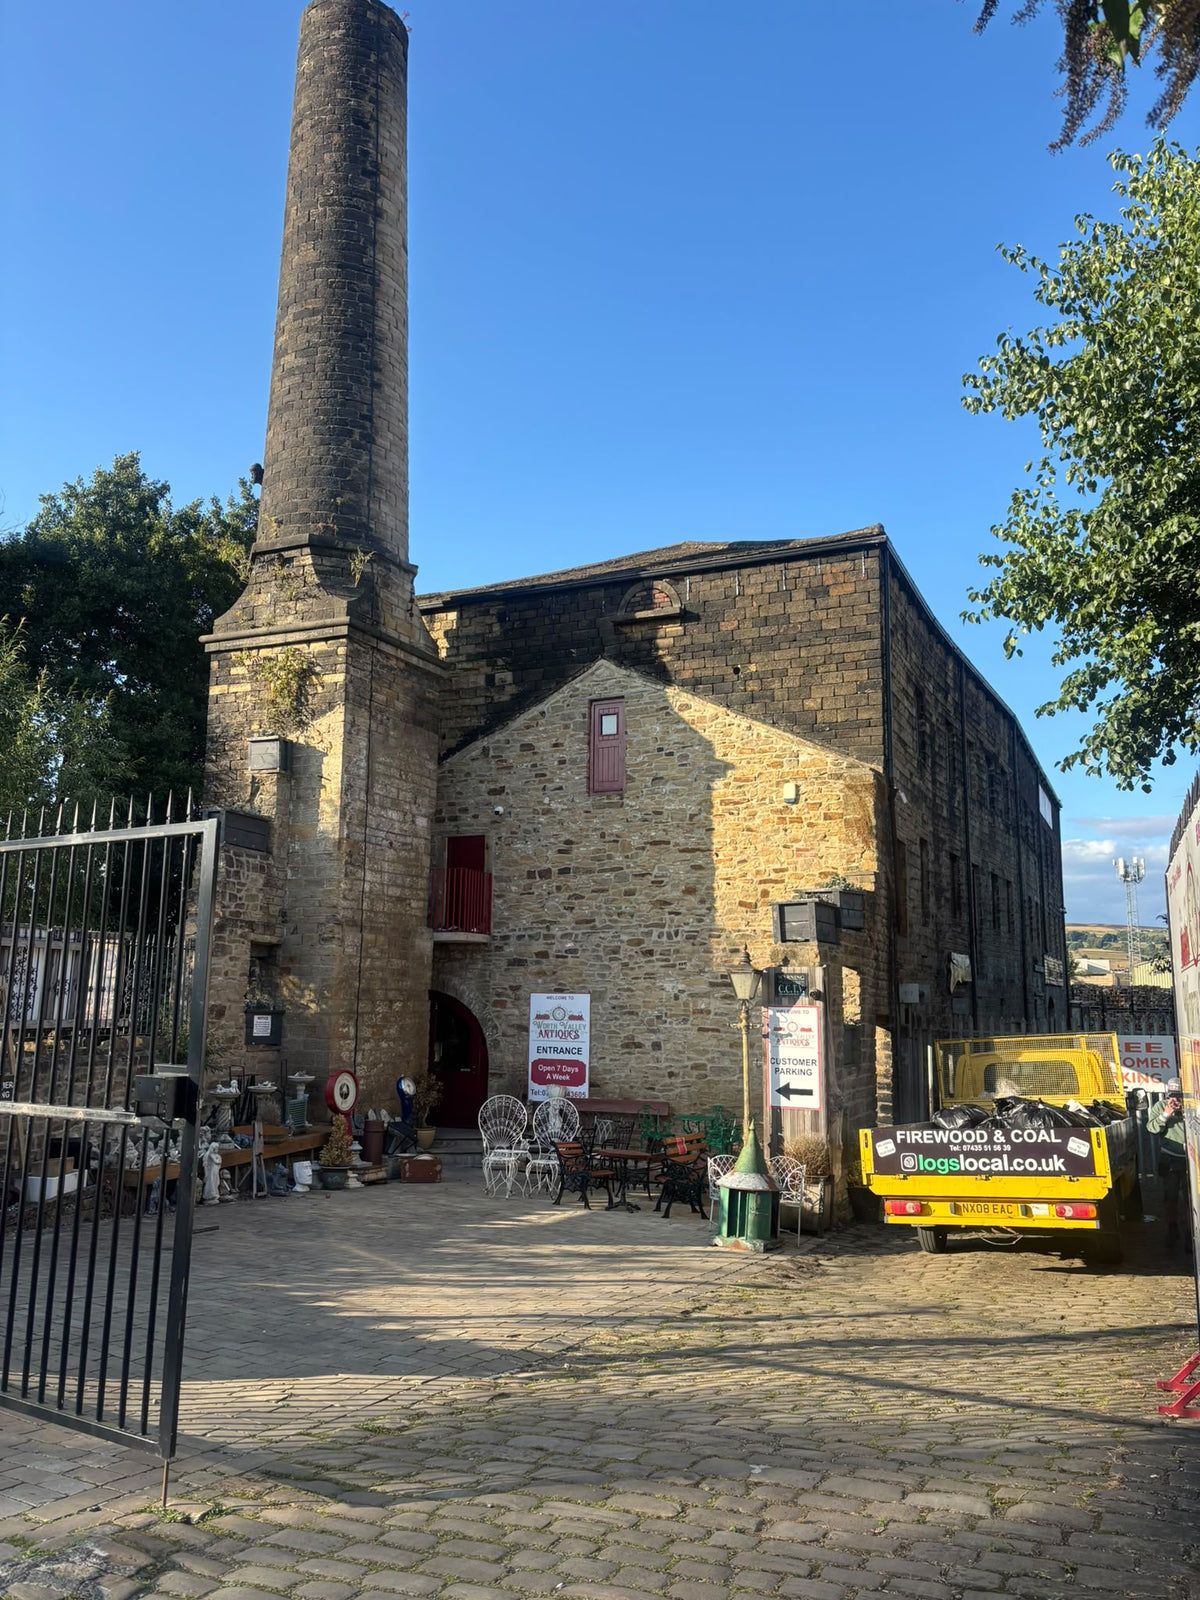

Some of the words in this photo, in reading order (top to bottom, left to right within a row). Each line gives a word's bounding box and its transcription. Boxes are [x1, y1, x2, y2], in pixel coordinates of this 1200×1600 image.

[532, 1021, 558, 1029] WORTH
[559, 1021, 586, 1030] VALLEY
[536, 1029, 580, 1040] ANTIQUES
[776, 1038, 810, 1046] ANTIQUES
[536, 1045, 583, 1055] ENTRANCE
[770, 1057, 817, 1066] CUSTOMER
[538, 1064, 555, 1072] Open
[562, 1065, 579, 1073] Days
[774, 1067, 813, 1076] PARKING
[896, 1129, 988, 1144] FIREWOOD
[993, 1129, 1006, 1143] &
[1010, 1129, 1062, 1143] COAL
[949, 1144, 962, 1152] Tel:
[962, 1144, 982, 1152] 07435
[983, 1144, 992, 1152] 51
[918, 1153, 1067, 1174] logslocal.co.uk
[962, 1203, 990, 1214] NX08
[992, 1204, 1013, 1214] EAC
